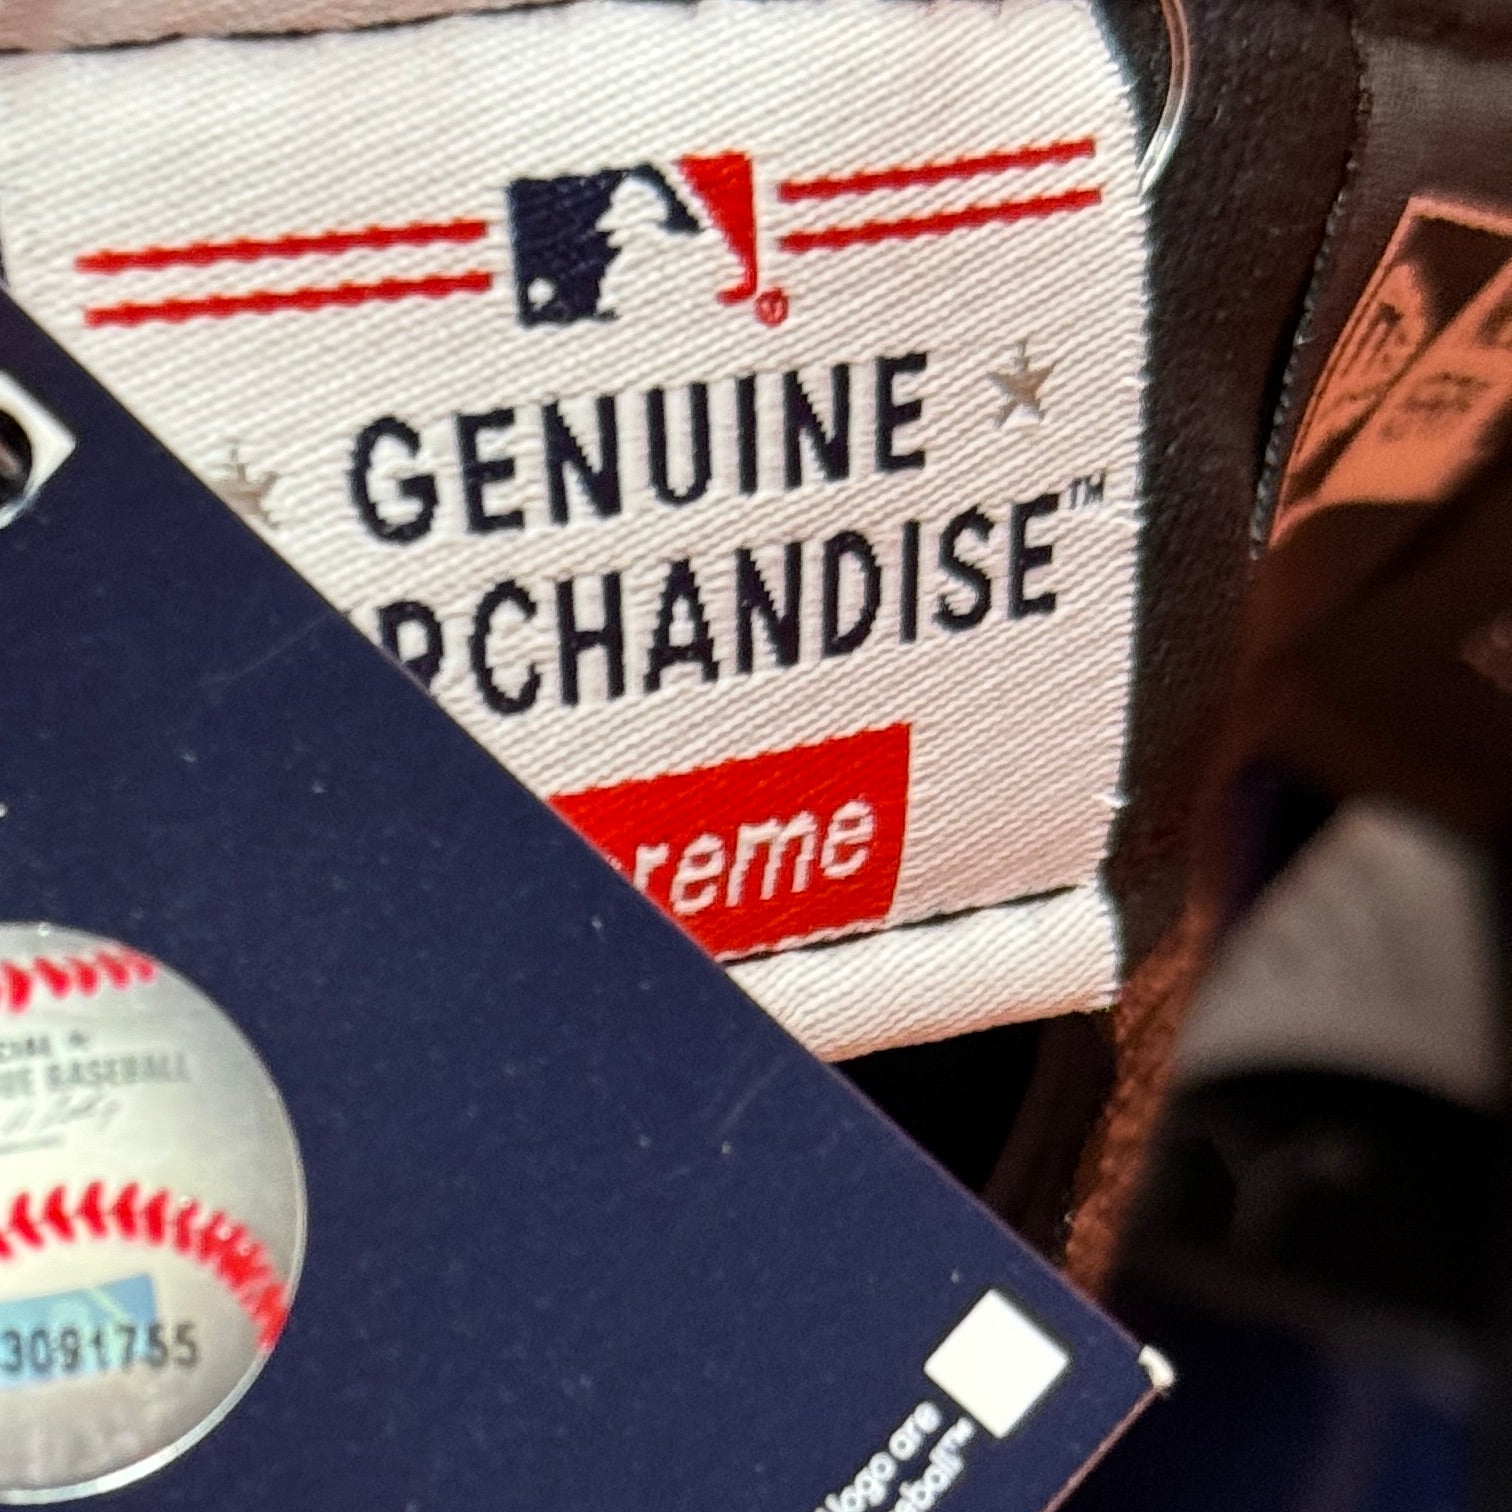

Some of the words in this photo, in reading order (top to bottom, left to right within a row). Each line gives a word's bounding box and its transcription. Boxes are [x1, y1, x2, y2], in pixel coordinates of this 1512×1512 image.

[348, 352, 928, 545] GENUINE
[378, 468, 1106, 716] RCHANDISE™
[605, 794, 876, 917] reme
[44, 1052, 191, 1093] BASEBALL
[889, 1402, 941, 1460] are
